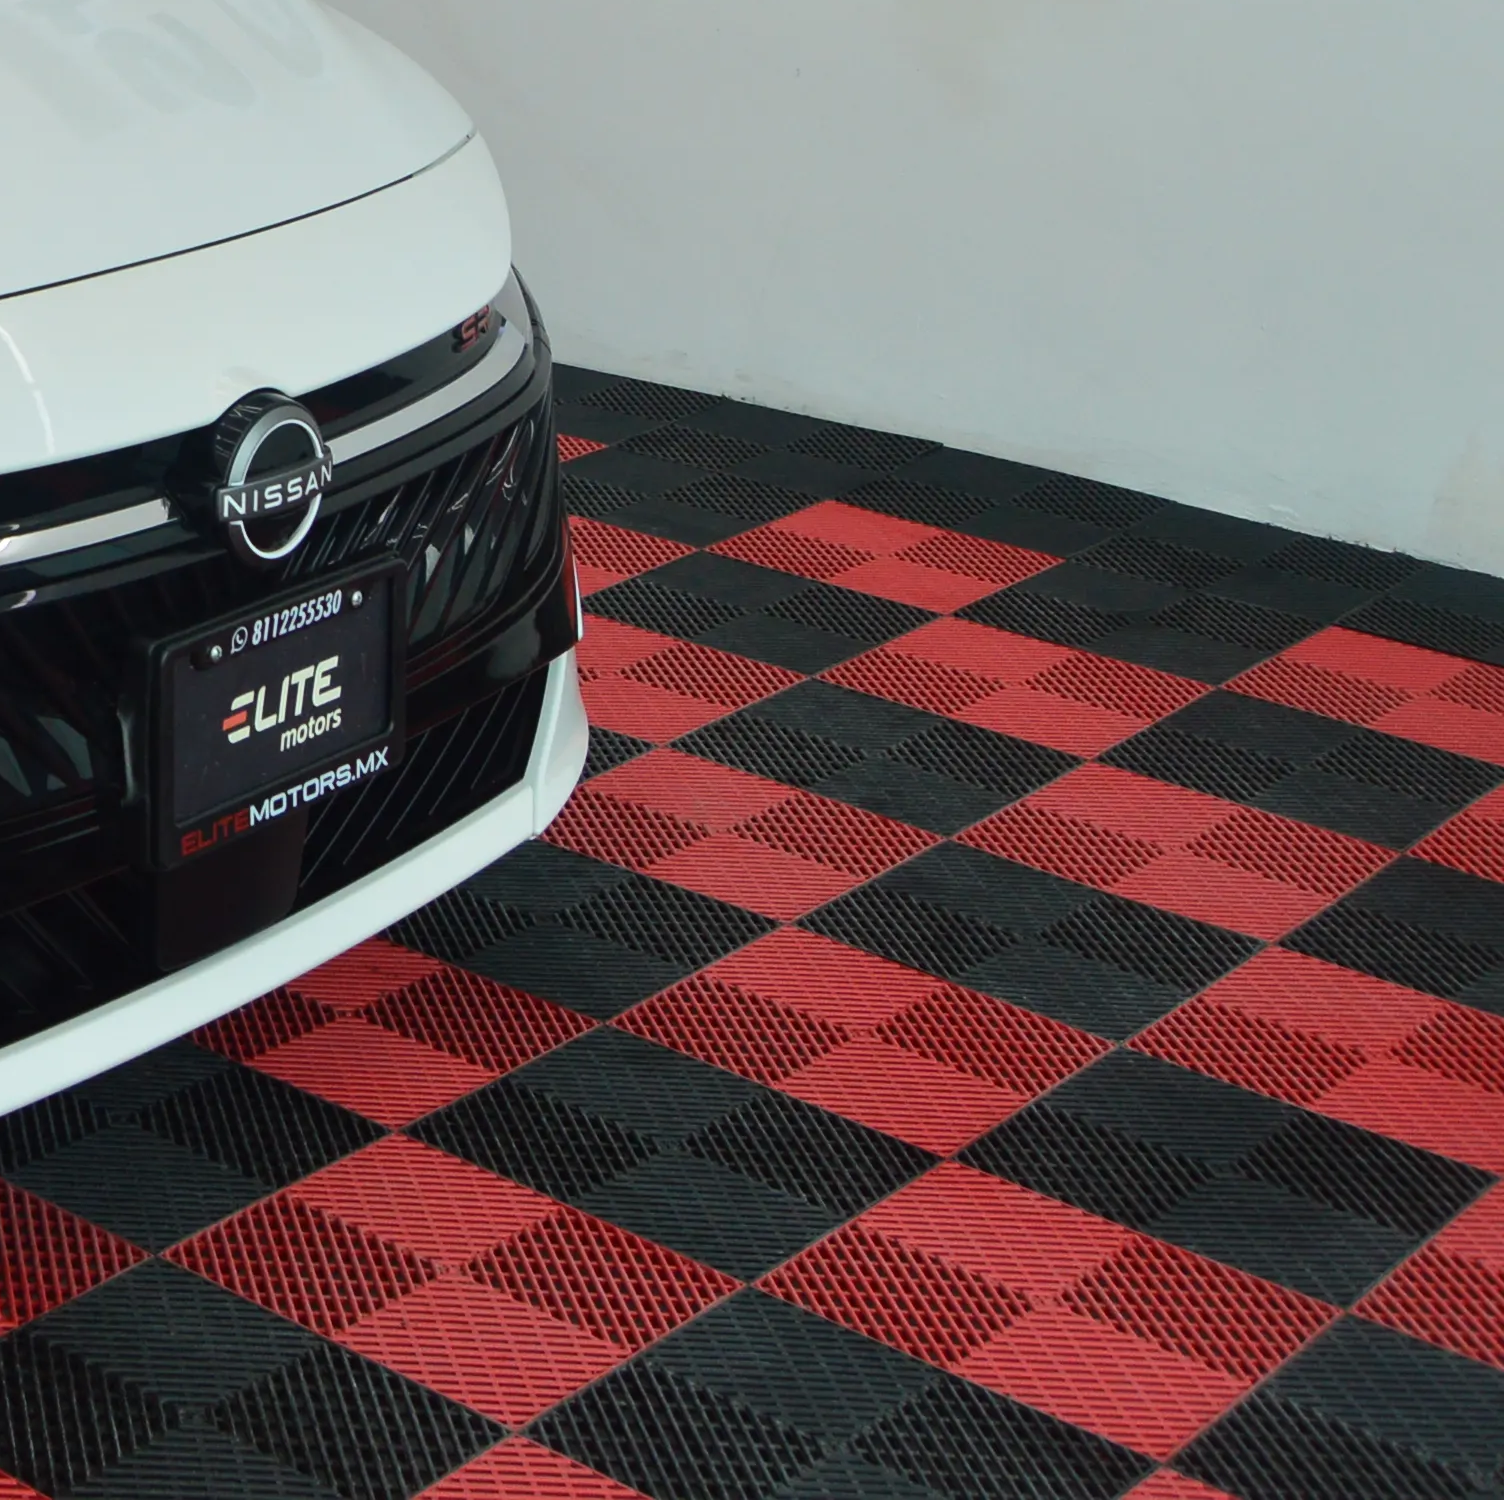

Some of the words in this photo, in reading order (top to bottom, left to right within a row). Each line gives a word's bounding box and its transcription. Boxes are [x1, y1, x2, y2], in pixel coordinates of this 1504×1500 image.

[222, 460, 333, 518] NISSAN
[252, 589, 342, 645] 8112255530
[222, 655, 342, 744] ELITE
[280, 708, 342, 752] motors
[181, 746, 389, 856] ELITEMOTORS.MX
